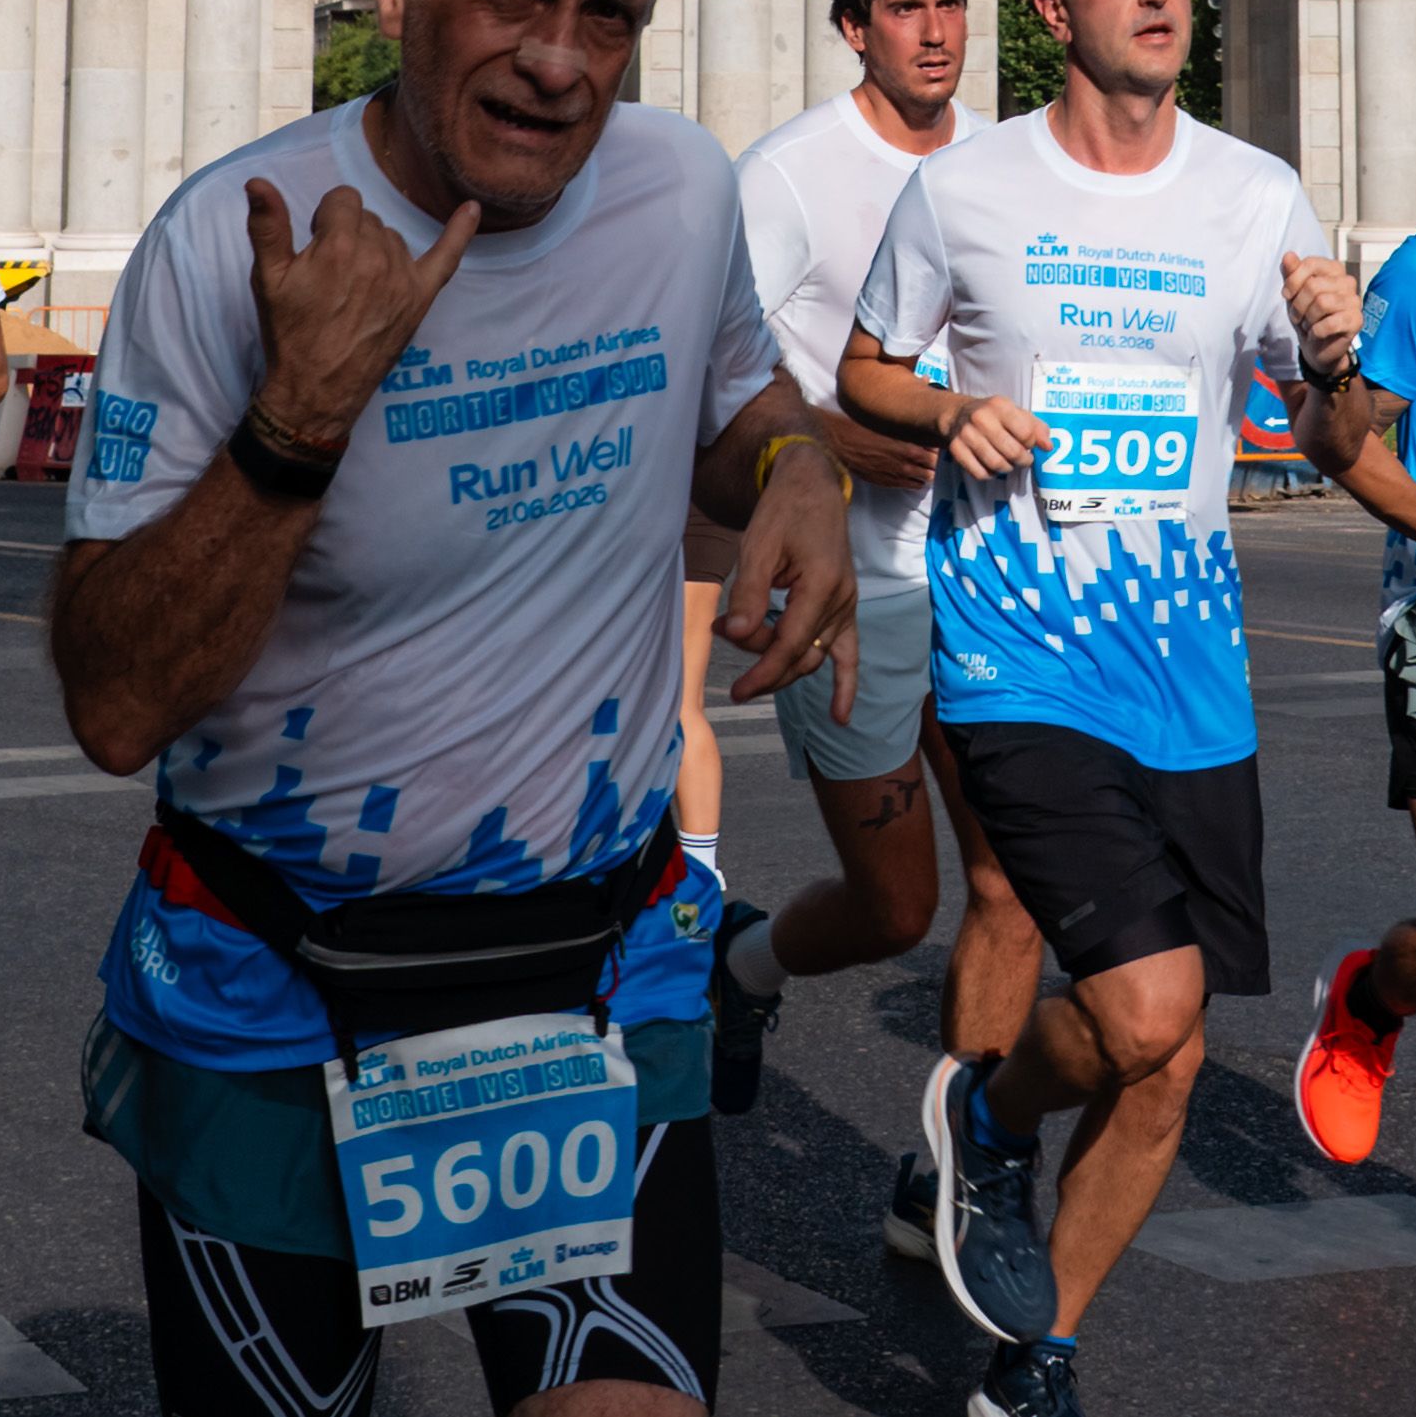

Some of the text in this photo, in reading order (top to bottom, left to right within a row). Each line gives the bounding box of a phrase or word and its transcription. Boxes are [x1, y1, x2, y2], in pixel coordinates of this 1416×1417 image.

[1026, 245, 1205, 269] KLM Royal Dutch Airlines
[1027, 263, 1205, 297] NORTE VS SUR
[1060, 303, 1177, 333] Run Well
[1080, 333, 1155, 350] 21.06.2026
[381, 326, 661, 393] KLM Royal Dutch Airlines
[386, 354, 666, 443] NORTE VS SUR
[1046, 376, 1080, 385] KLM
[1087, 377, 1115, 389] Royal
[1047, 391, 1185, 411] NORTE VS SUR
[449, 425, 633, 505] Run Well
[1041, 427, 1188, 477] 2509
[486, 483, 607, 531] 21.06.2026
[1049, 499, 1072, 511] BM
[1114, 506, 1142, 515] KLM
[349, 1065, 406, 1092] KLM
[417, 1057, 468, 1079] Royal
[471, 1041, 528, 1065] Dutch
[353, 1053, 607, 1129] NORTE VS SUR
[361, 1120, 618, 1238] 5600
[500, 1259, 545, 1286] KLM
[394, 1276, 431, 1303] BM
